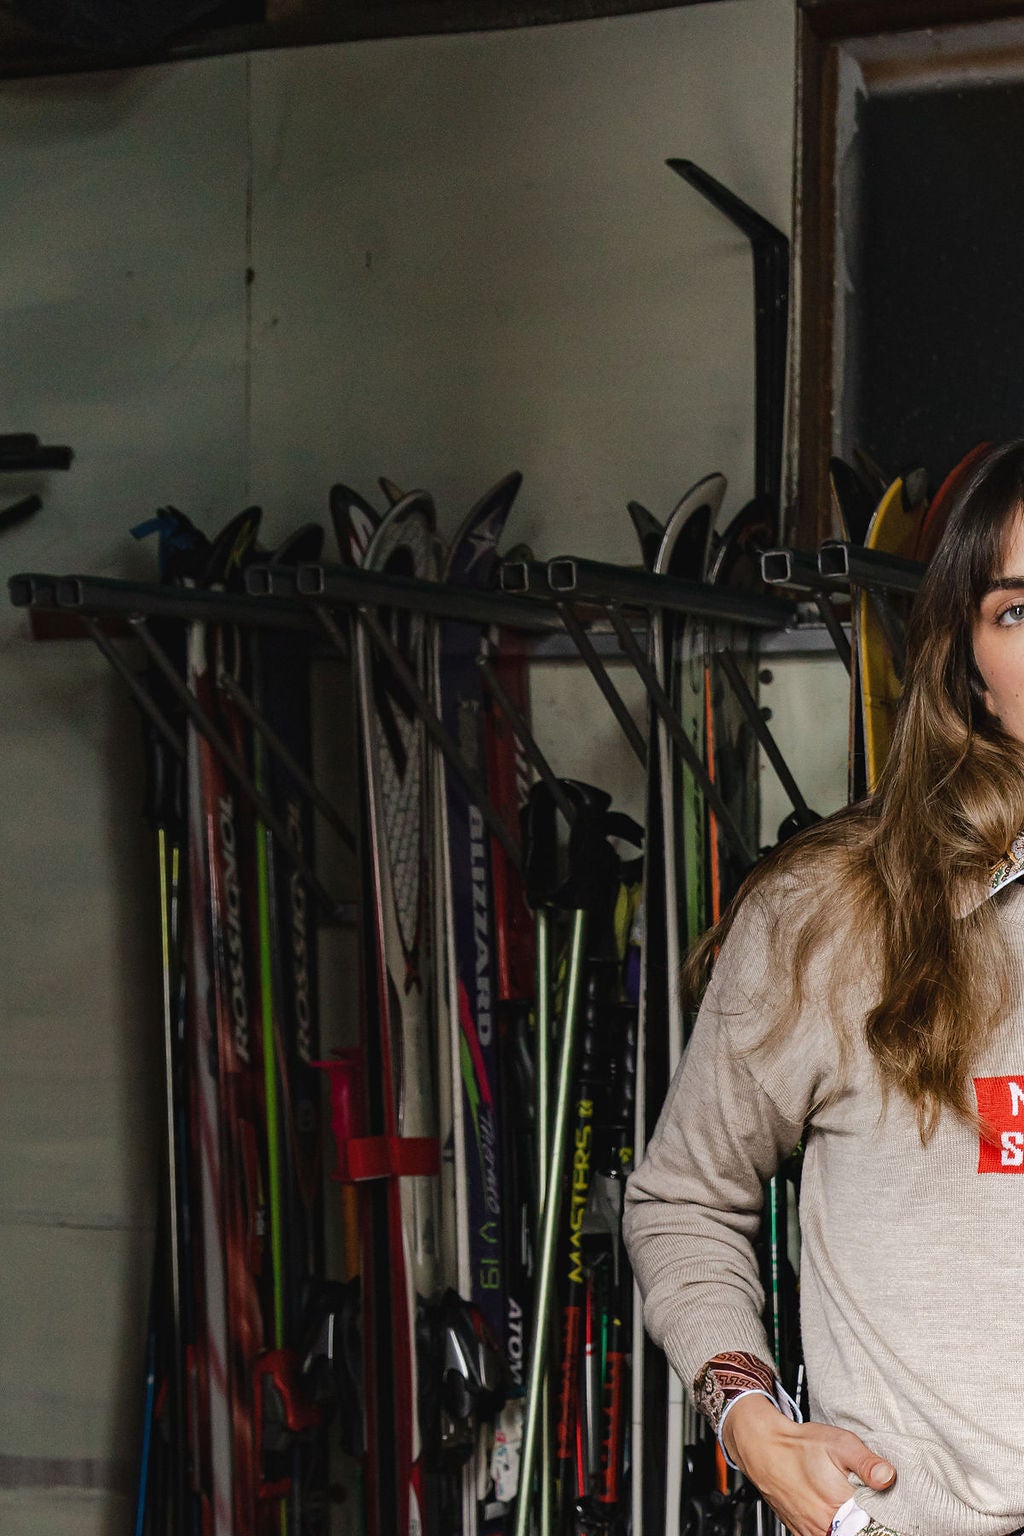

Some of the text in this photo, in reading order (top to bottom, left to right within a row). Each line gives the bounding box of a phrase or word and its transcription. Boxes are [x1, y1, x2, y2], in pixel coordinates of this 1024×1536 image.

[219, 795, 251, 1064] ROSSIGNOL
[287, 802, 311, 1064] ROSSIGOL
[468, 803, 493, 1047] BLIZZARD
[480, 1222, 500, 1290] V 19
[567, 1124, 592, 1285] MASTERS
